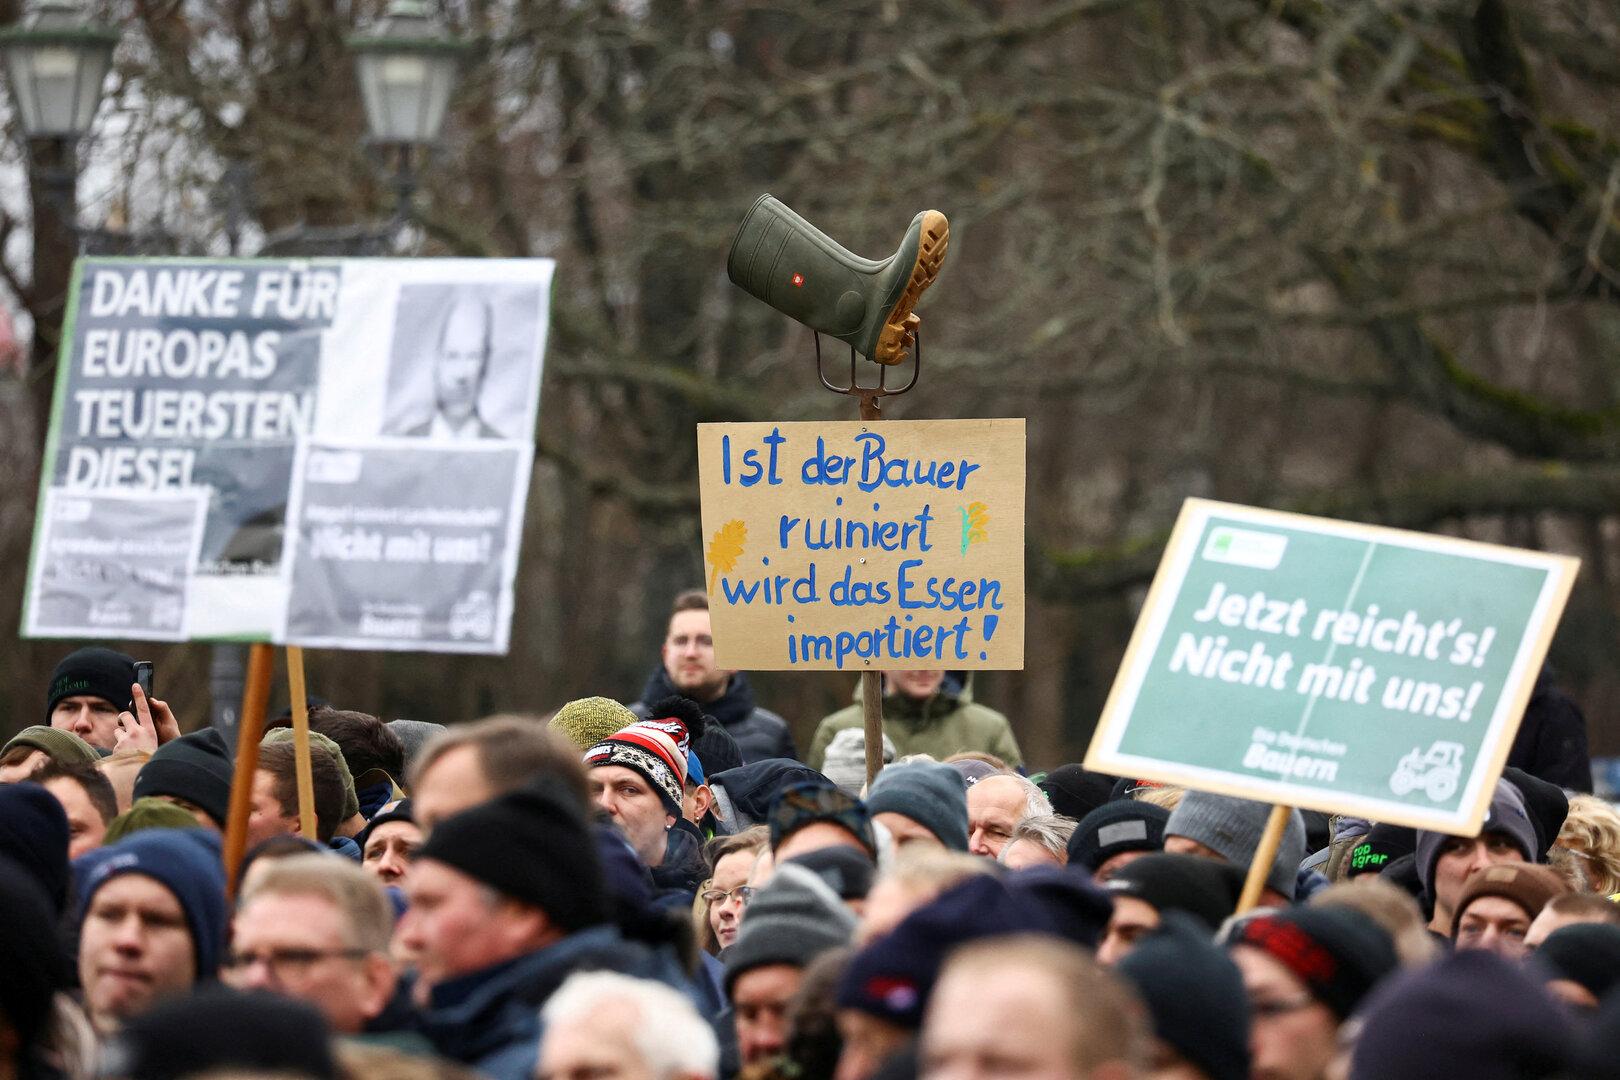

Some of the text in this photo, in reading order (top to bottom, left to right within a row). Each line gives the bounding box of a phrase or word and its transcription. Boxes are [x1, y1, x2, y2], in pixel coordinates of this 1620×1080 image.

[90, 261, 339, 319] DANKE FÜR
[82, 328, 281, 379] EUROPAS
[75, 389, 314, 440] TEUERSTEN
[722, 427, 981, 493] Ist der Bauer
[779, 497, 934, 551] ruiniert
[721, 557, 1004, 611] wird das Essen
[1194, 582, 1307, 637] Jetzt
[1169, 632, 1484, 722] Nicht mit uns!
[1242, 742, 1339, 782] Bauern
